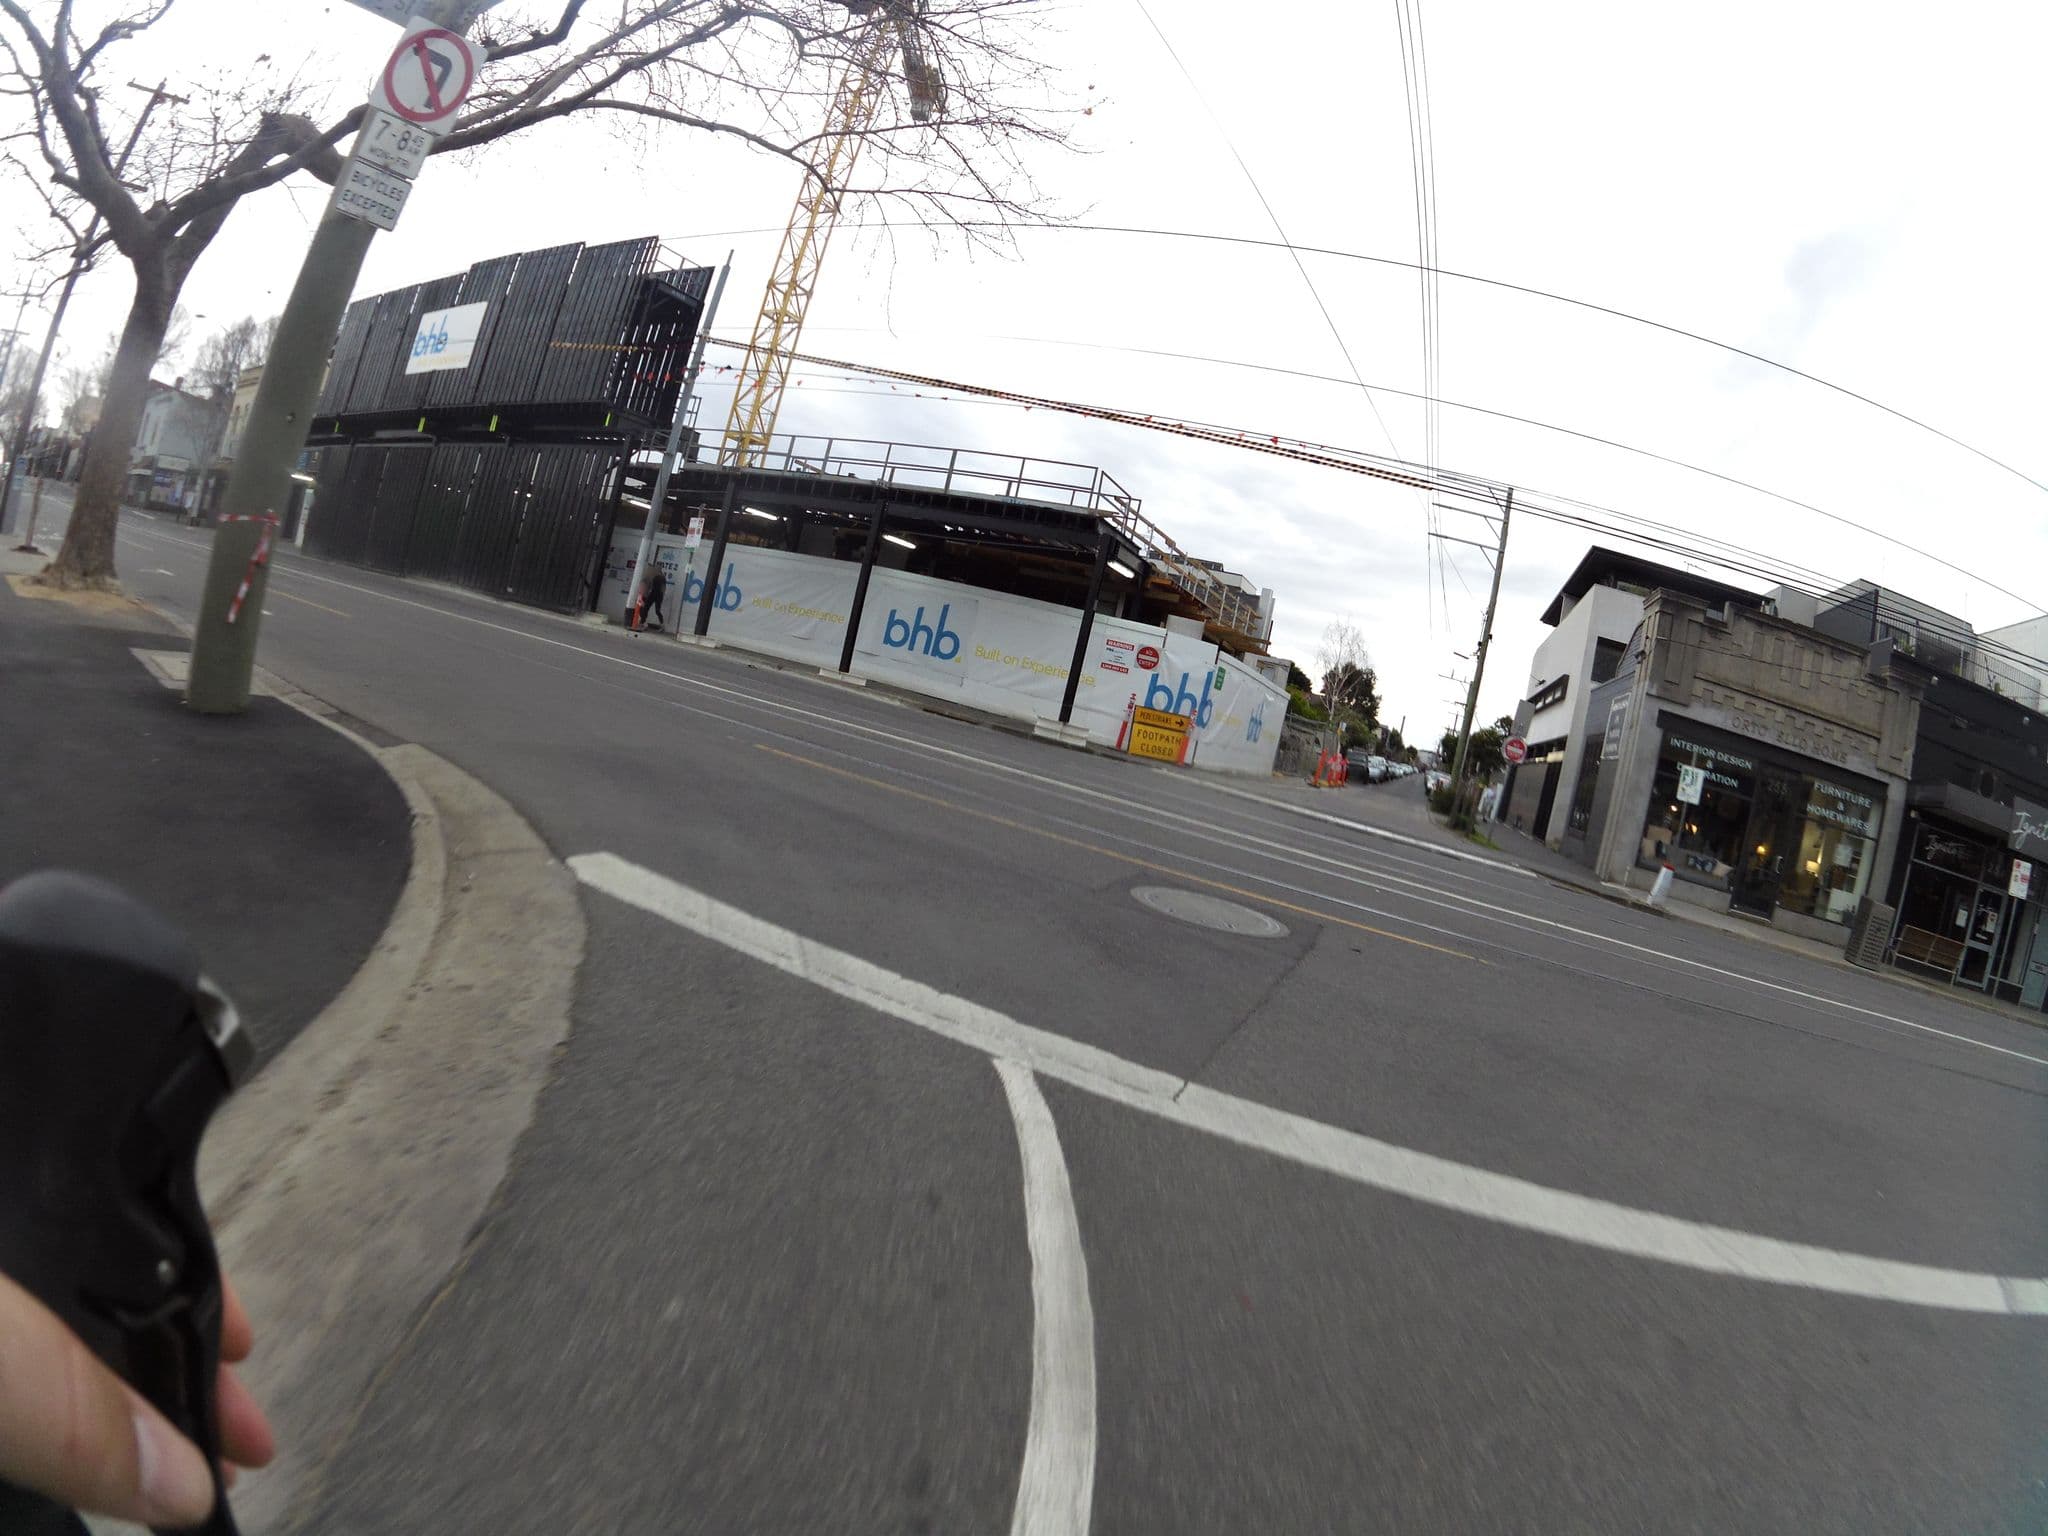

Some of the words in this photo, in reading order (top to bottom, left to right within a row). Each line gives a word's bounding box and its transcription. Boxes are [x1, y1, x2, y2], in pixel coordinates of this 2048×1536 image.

[352, 170, 404, 202] BICYCLES
[342, 189, 398, 220] EXCEPTED
[975, 643, 1000, 663] Built
[1003, 654, 1020, 667] on
[1136, 728, 1183, 746] FOOTPATH
[1140, 743, 1174, 757] CLOSED
[1670, 737, 1716, 759] INTERIOR
[1716, 752, 1753, 770] DESIGN
[1706, 760, 1713, 769] &
[1814, 781, 1872, 808] FURNITURE
[1837, 801, 1845, 811] &
[1806, 803, 1872, 831] HOMEWARES
